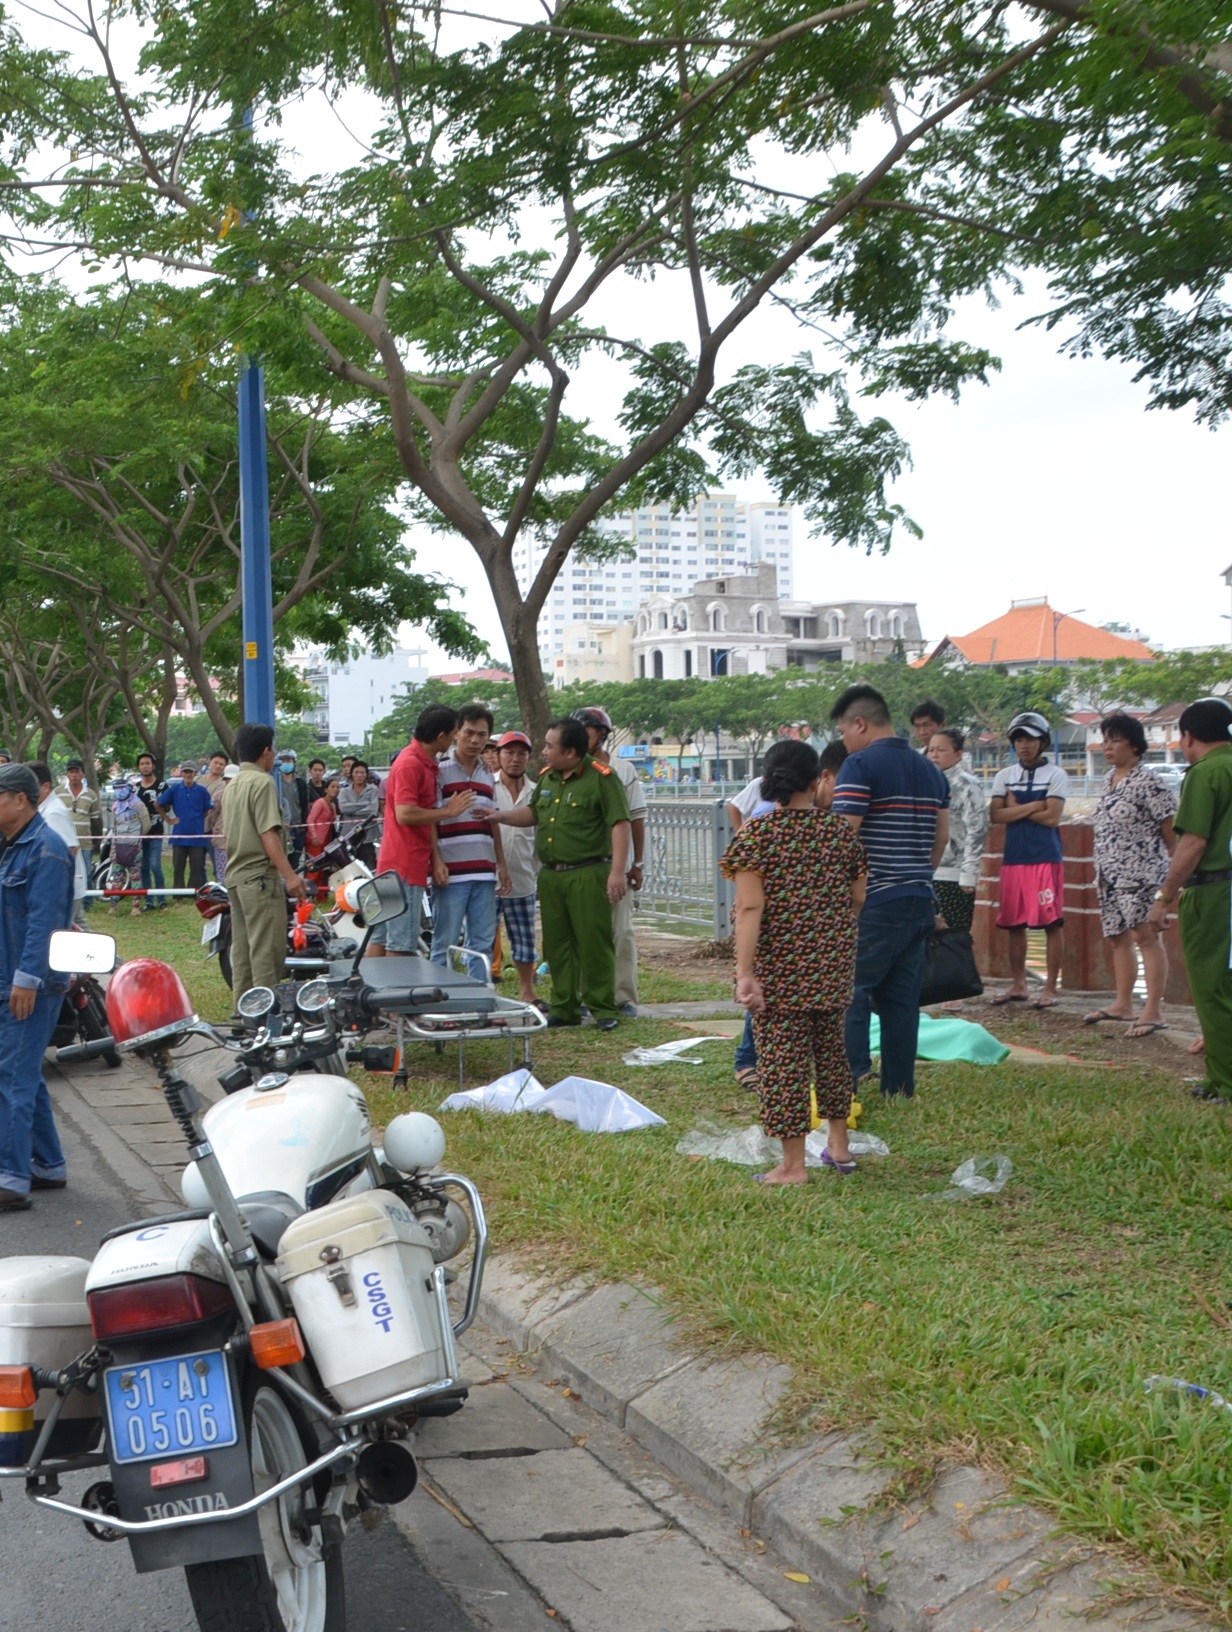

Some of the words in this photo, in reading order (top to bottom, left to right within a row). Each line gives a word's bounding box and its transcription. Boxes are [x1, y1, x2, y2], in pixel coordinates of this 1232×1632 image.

[111, 1261, 159, 1275] HONDA
[363, 1271, 394, 1333] CSGT
[128, 1403, 218, 1454] 0506
[144, 1492, 230, 1521] HONDA
